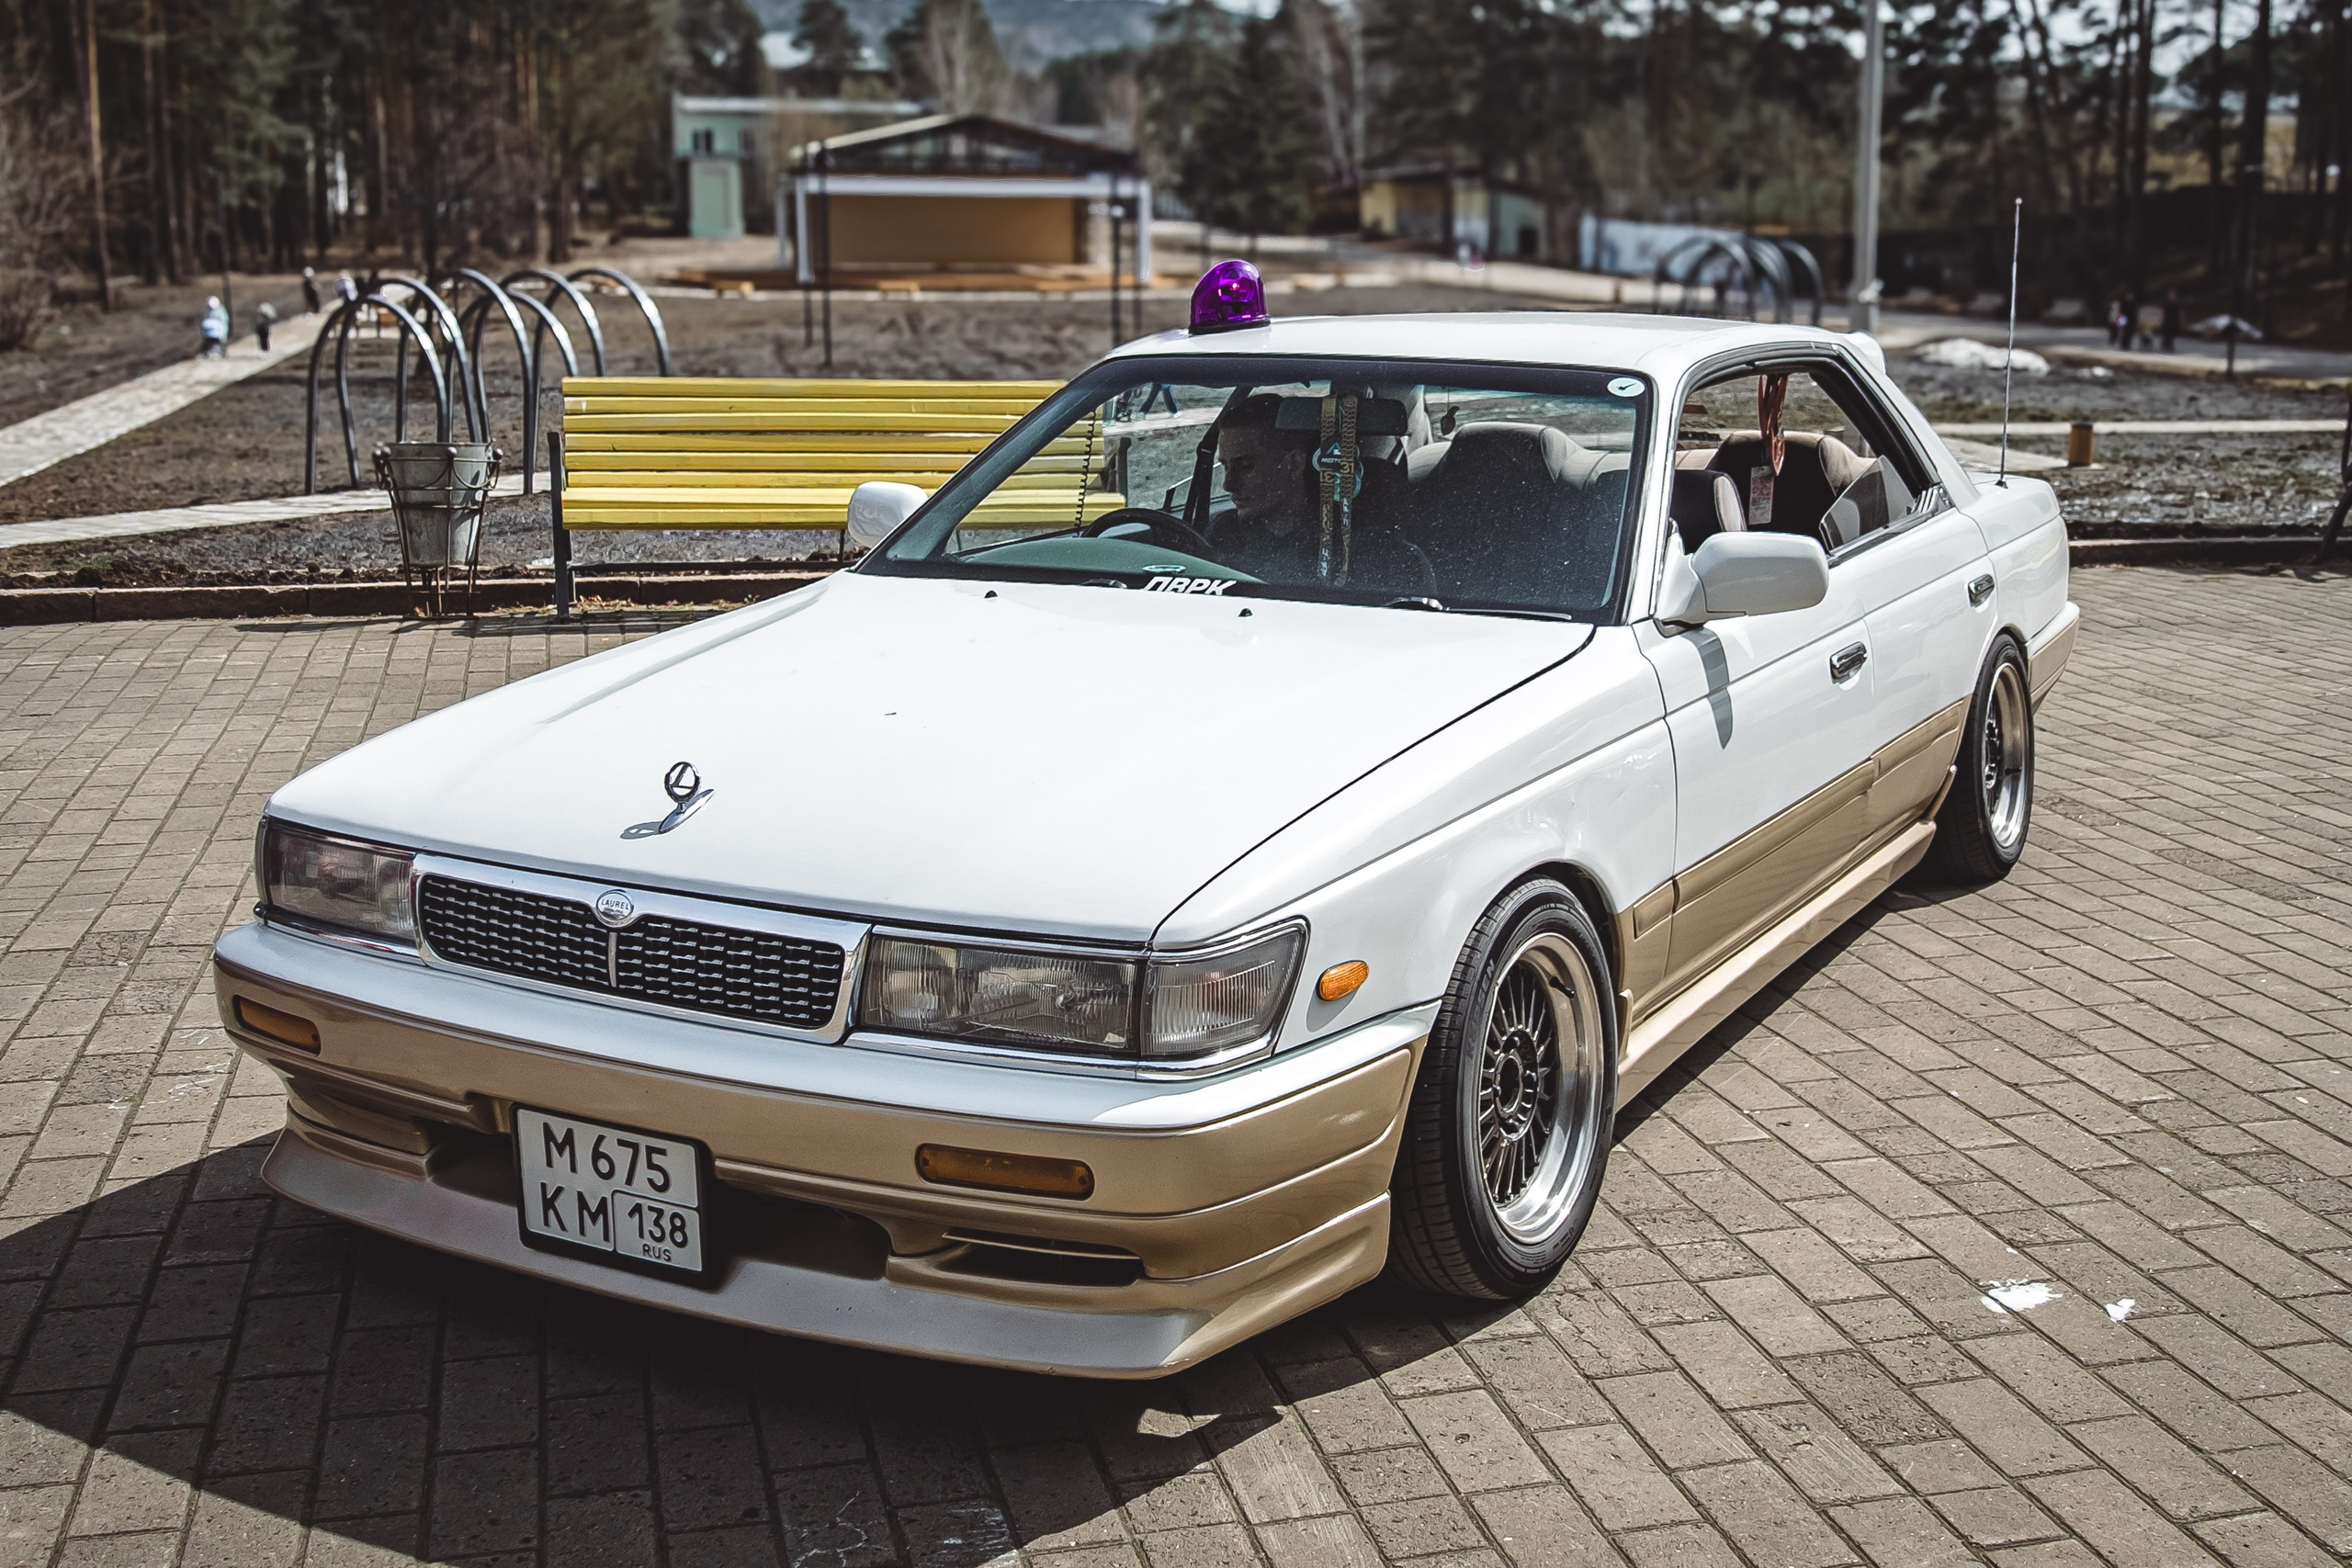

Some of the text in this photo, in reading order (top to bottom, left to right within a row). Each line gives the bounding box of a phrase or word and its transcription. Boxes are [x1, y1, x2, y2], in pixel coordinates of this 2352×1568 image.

[601, 898, 629, 910] LAUREL
[542, 1121, 672, 1193] M 675
[539, 1181, 610, 1243] KM
[628, 1201, 689, 1249] 138
[642, 1243, 673, 1263] RUS
